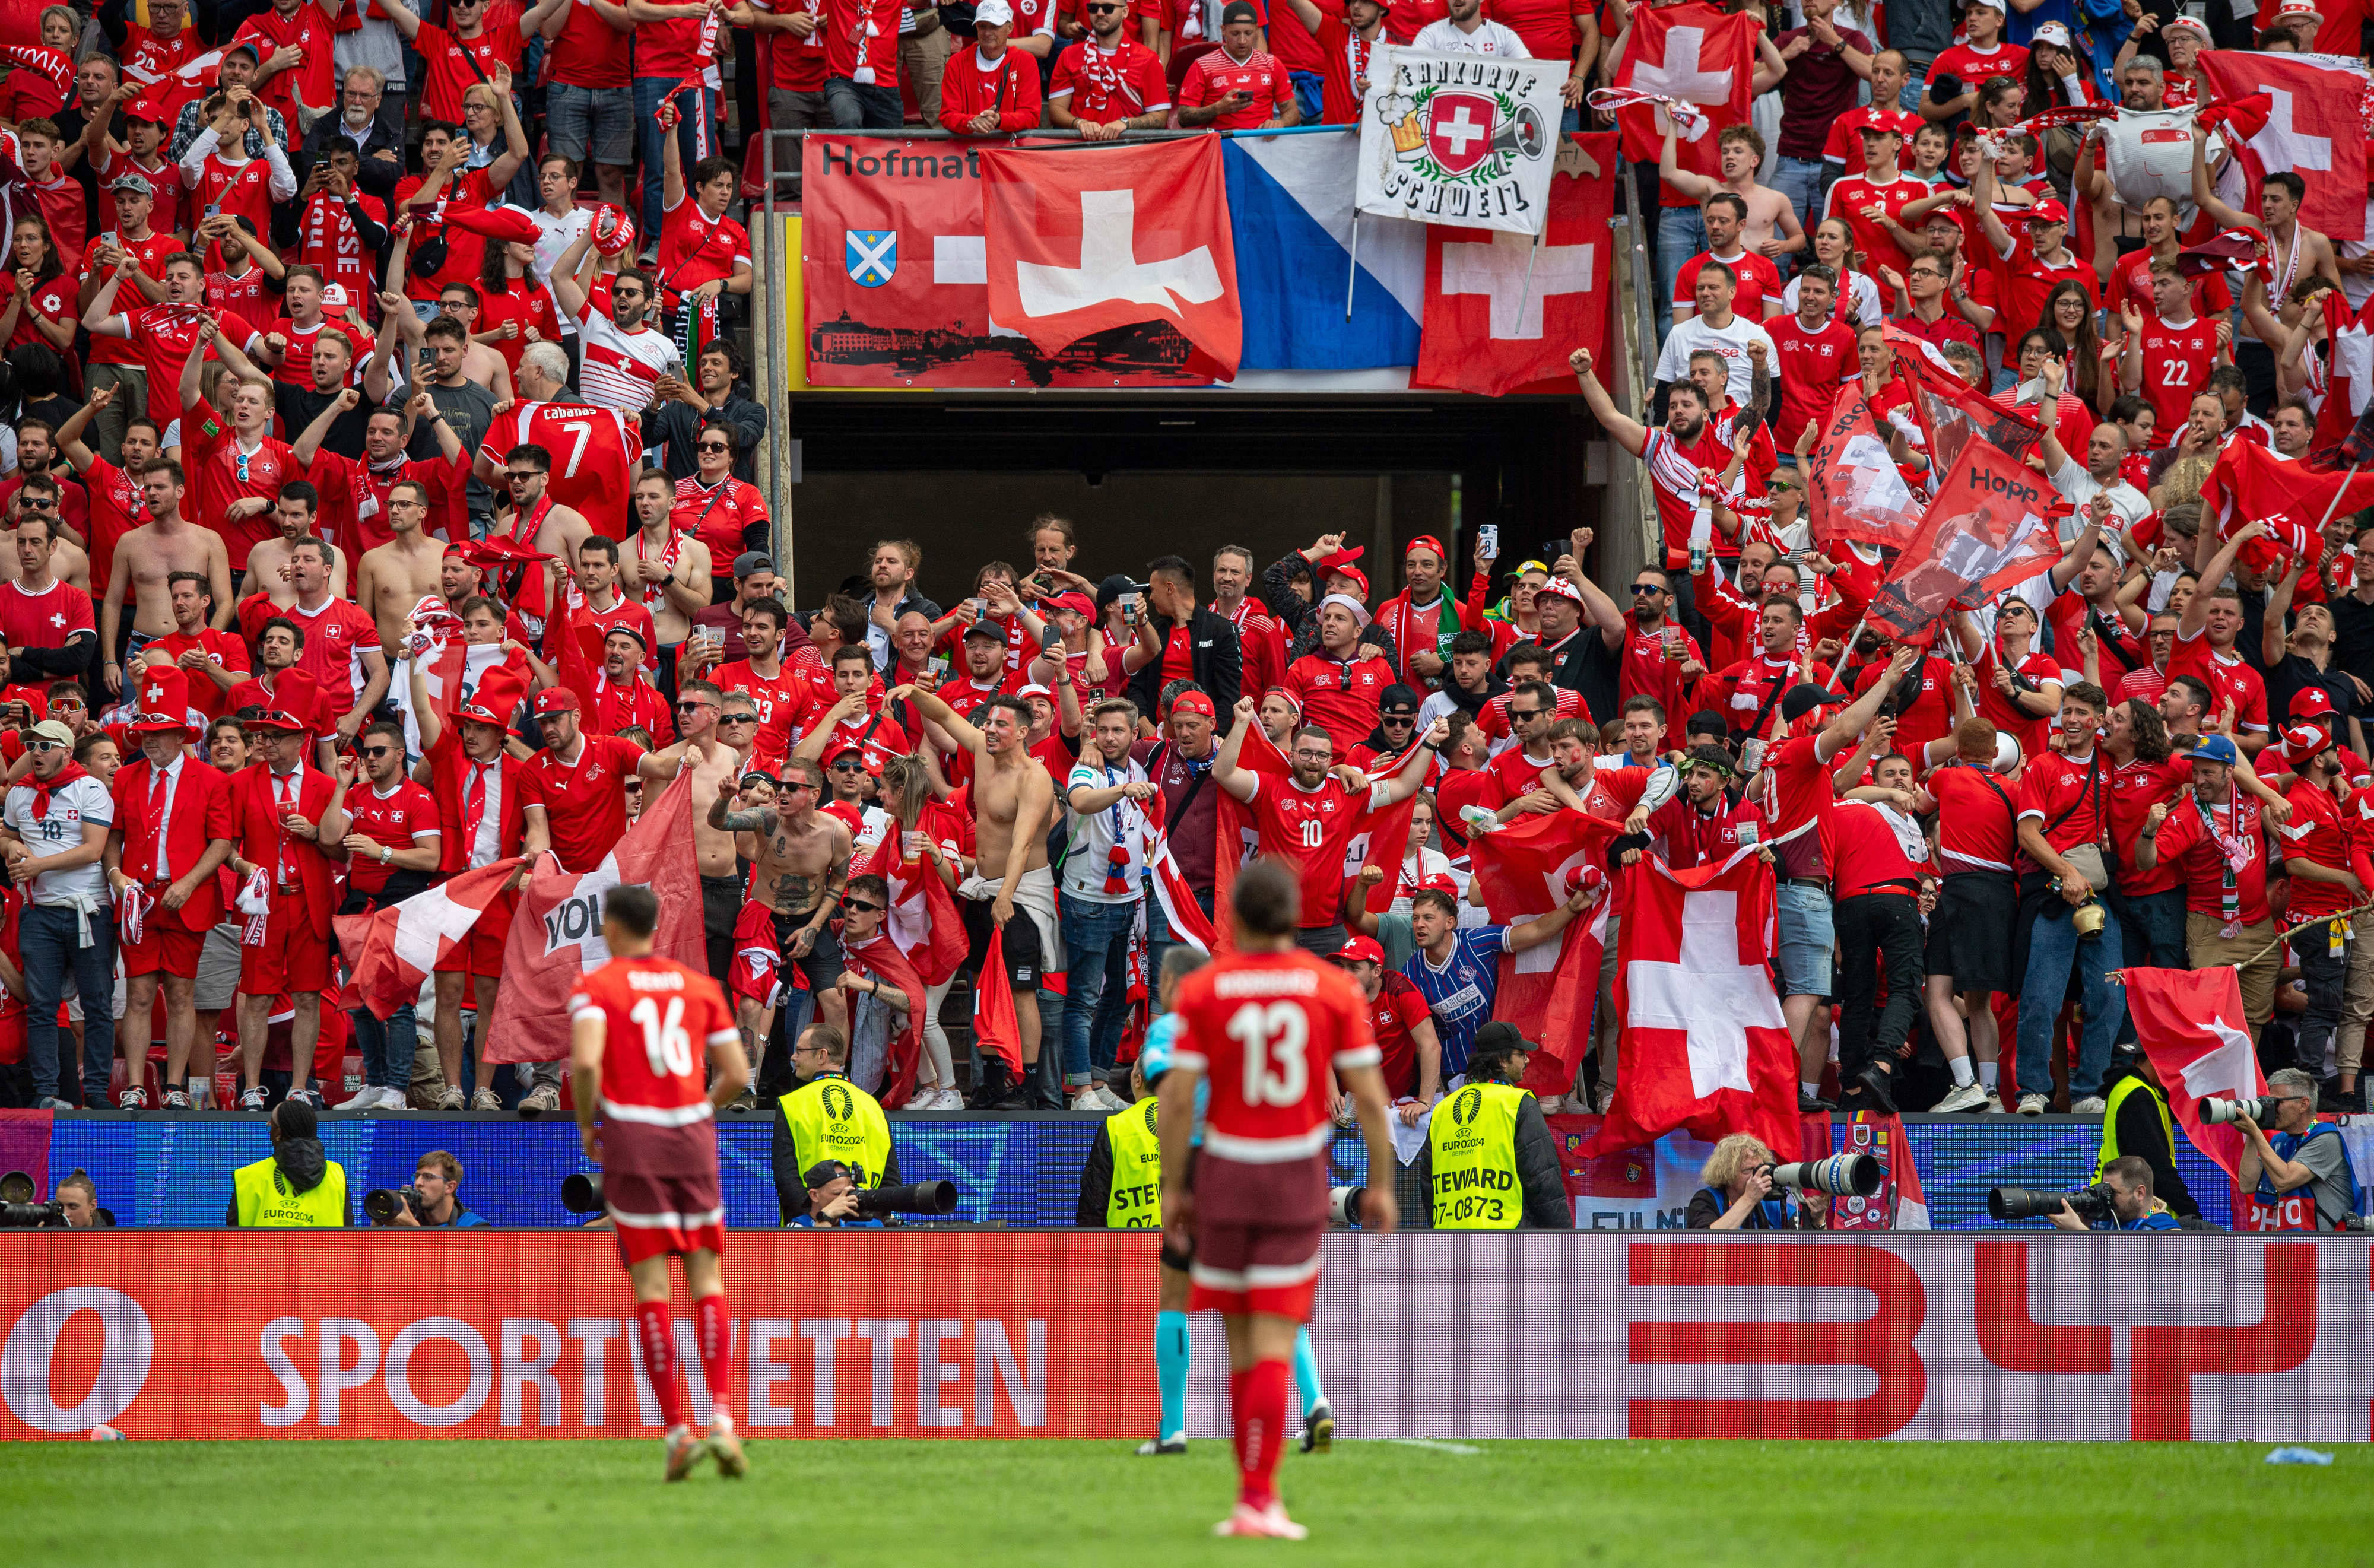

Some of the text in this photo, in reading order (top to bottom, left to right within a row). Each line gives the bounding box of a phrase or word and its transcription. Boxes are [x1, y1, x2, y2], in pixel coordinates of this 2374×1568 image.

[1400, 61, 1537, 98] FANKURVE
[1385, 170, 1530, 218] SCHWEIZ
[2163, 360, 2188, 386] 22
[556, 421, 592, 479] 7
[1970, 466, 2039, 503] Hopp
[39, 821, 62, 840] 10
[1299, 820, 1322, 847] 10
[1443, 998, 1480, 1021] FIAT
[630, 997, 693, 1079] 16
[1227, 1000, 1310, 1107] 13
[830, 1125, 848, 1135] UEFA
[1455, 1129, 1472, 1139] UEFA
[1452, 1148, 1475, 1158] GERMANY
[259, 1316, 1047, 1429] SPORTWETTEN
